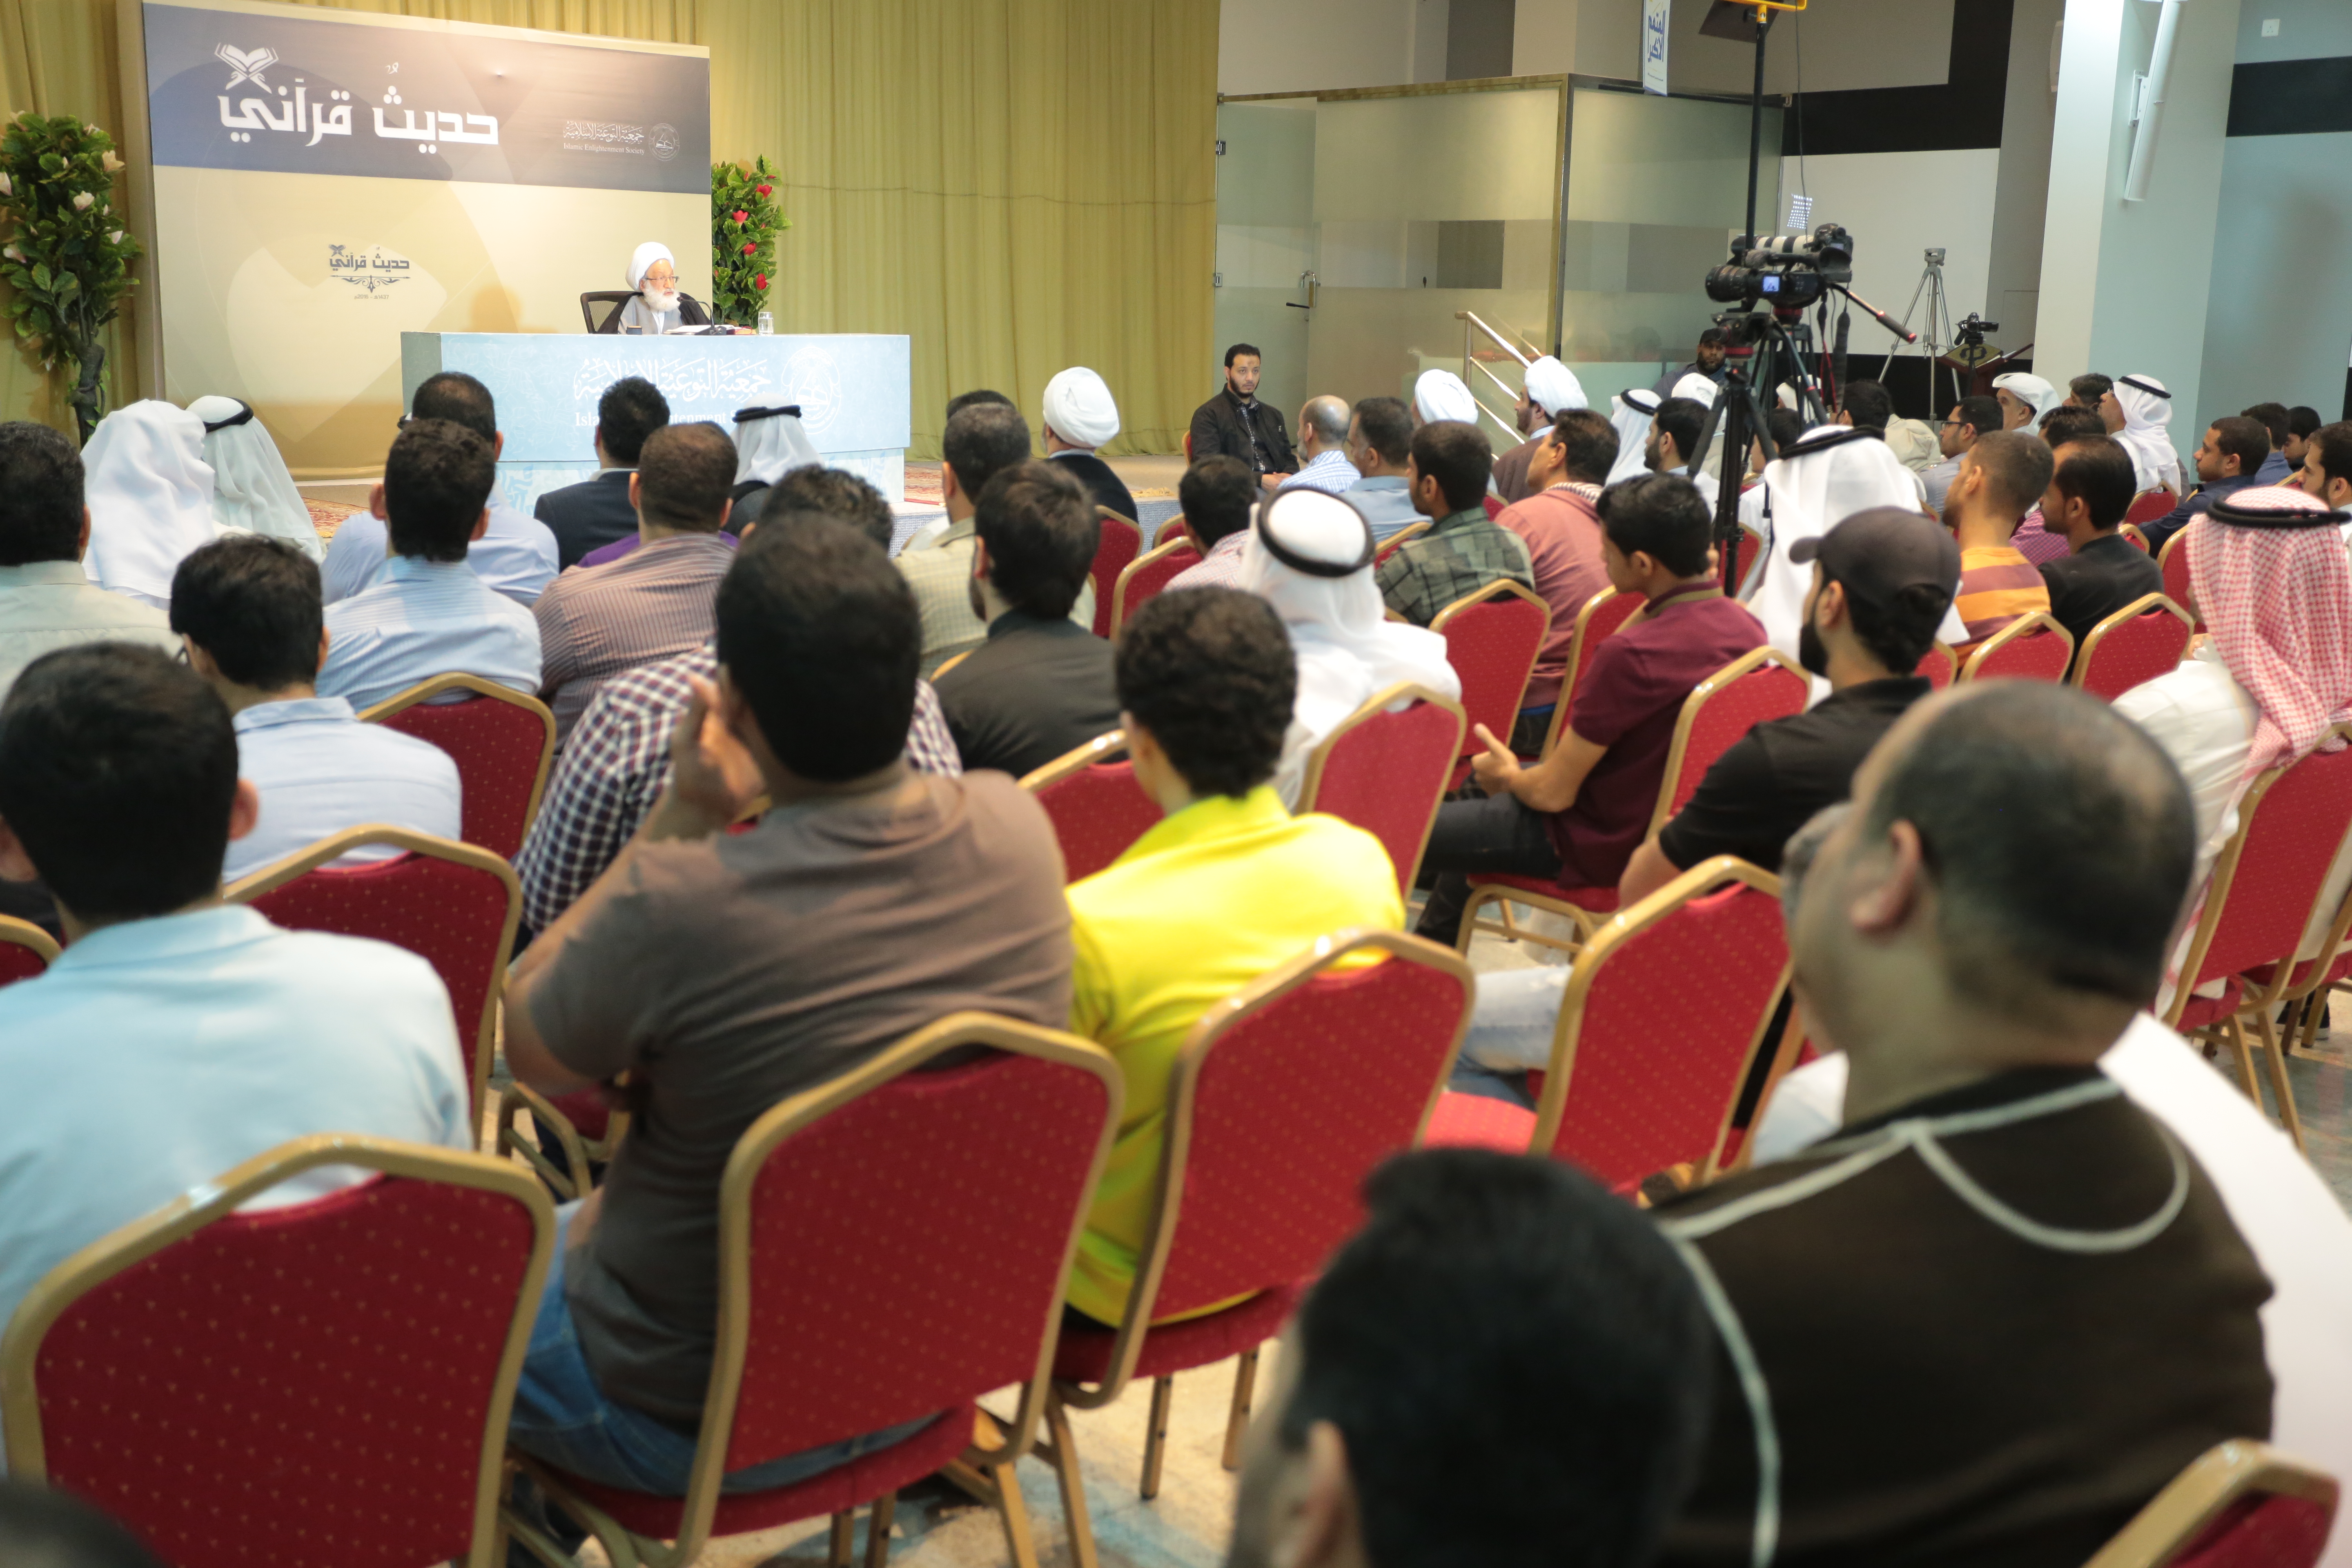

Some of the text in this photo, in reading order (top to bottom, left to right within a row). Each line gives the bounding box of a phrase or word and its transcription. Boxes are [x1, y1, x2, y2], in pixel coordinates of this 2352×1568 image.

[217, 78, 353, 147] قرآني
[585, 144, 624, 153] Enlightenment
[626, 147, 645, 155] Society
[330, 252, 366, 272] قرآني
[575, 412, 599, 426] Isla
